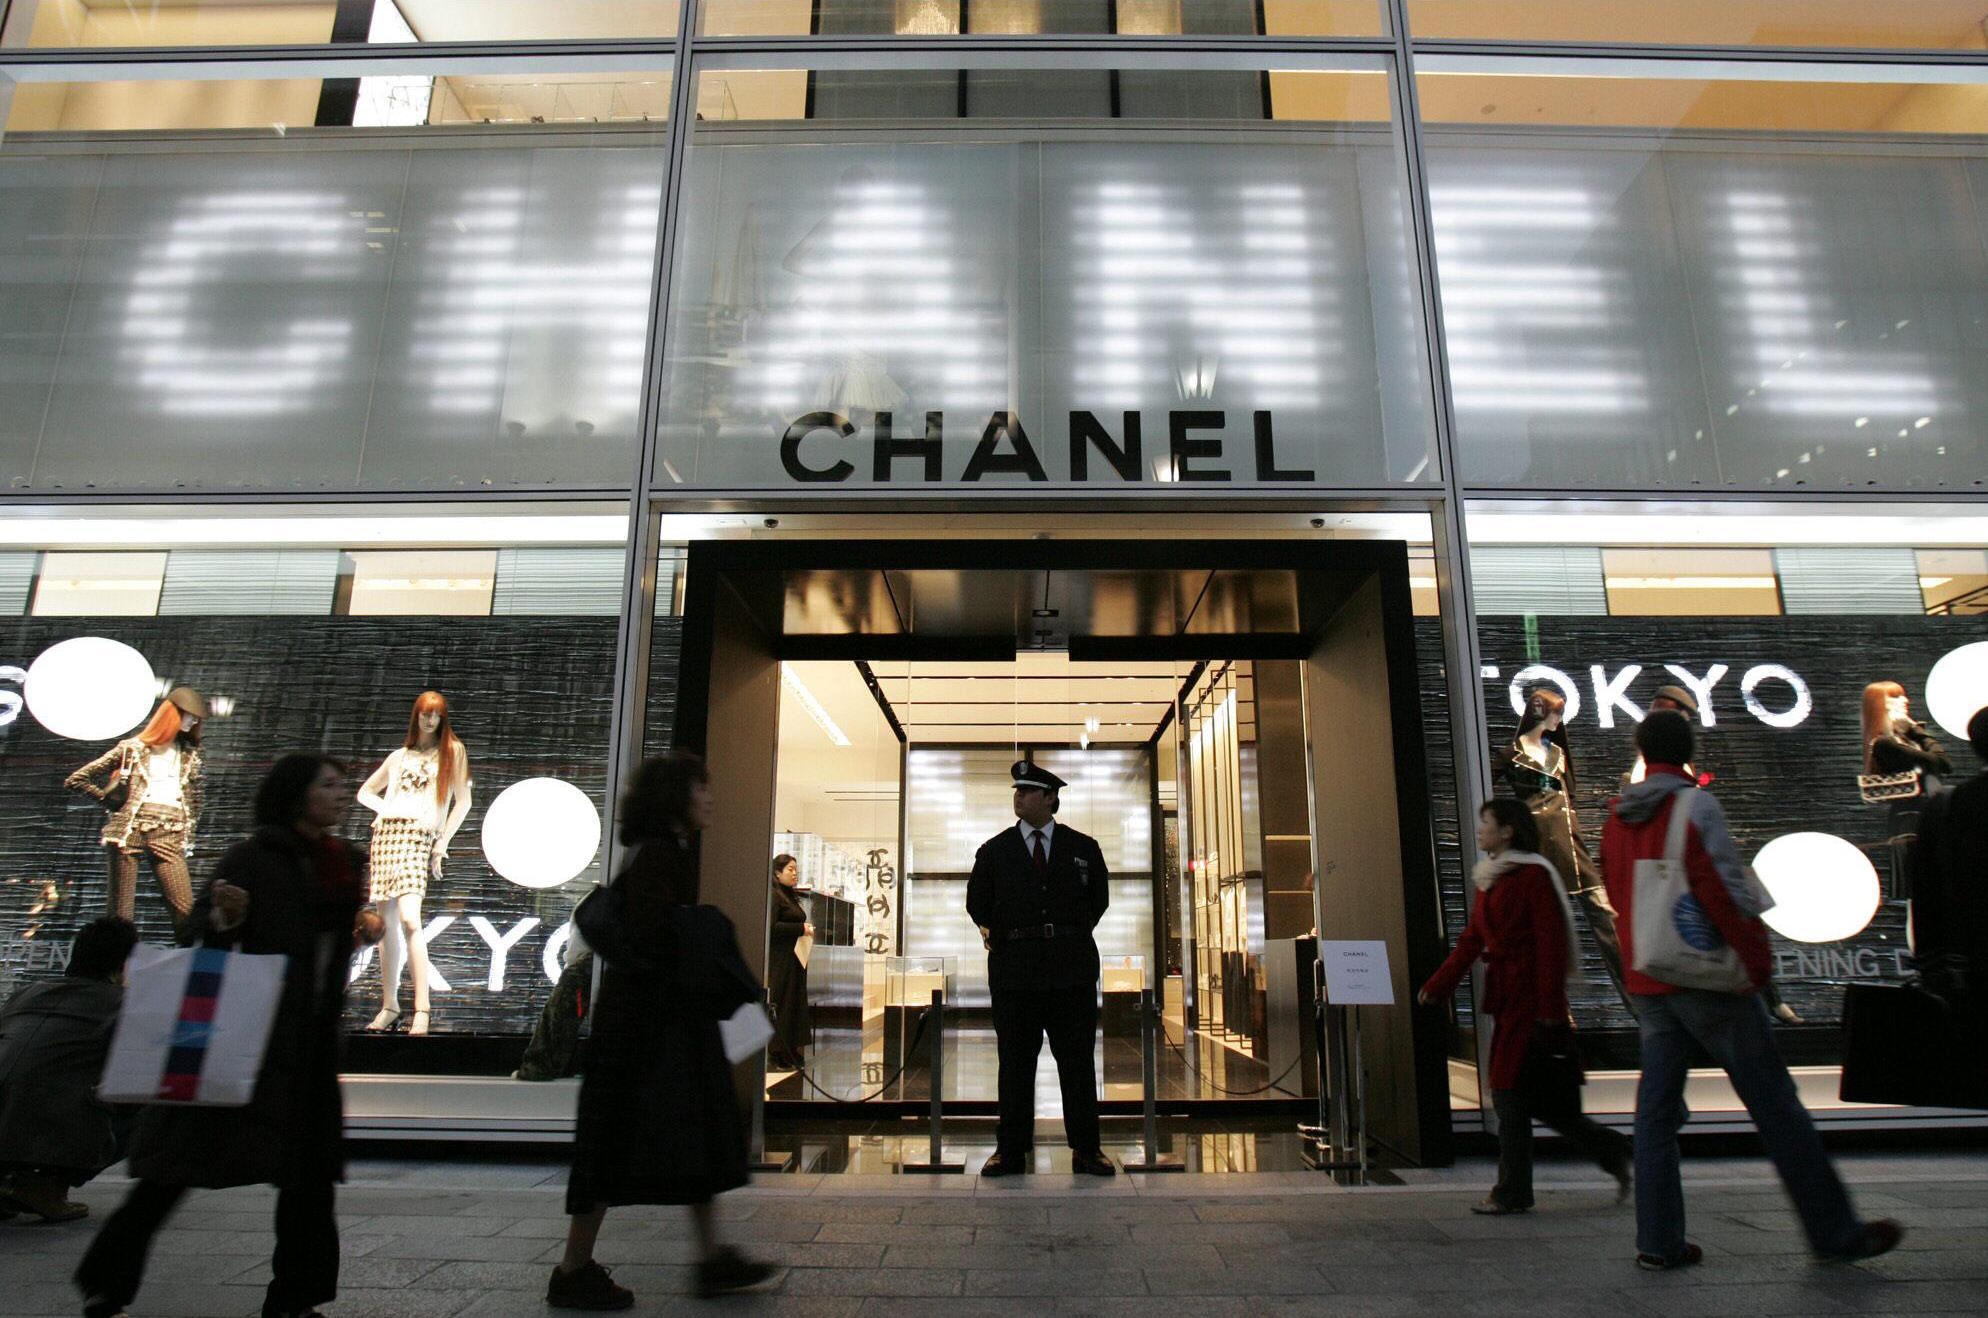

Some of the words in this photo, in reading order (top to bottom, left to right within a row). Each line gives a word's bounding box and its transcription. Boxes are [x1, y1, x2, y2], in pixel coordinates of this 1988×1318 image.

[118, 178, 1962, 418] CHANEL
[779, 410, 1315, 482] CHANEL
[1480, 664, 1812, 728] OKYO
